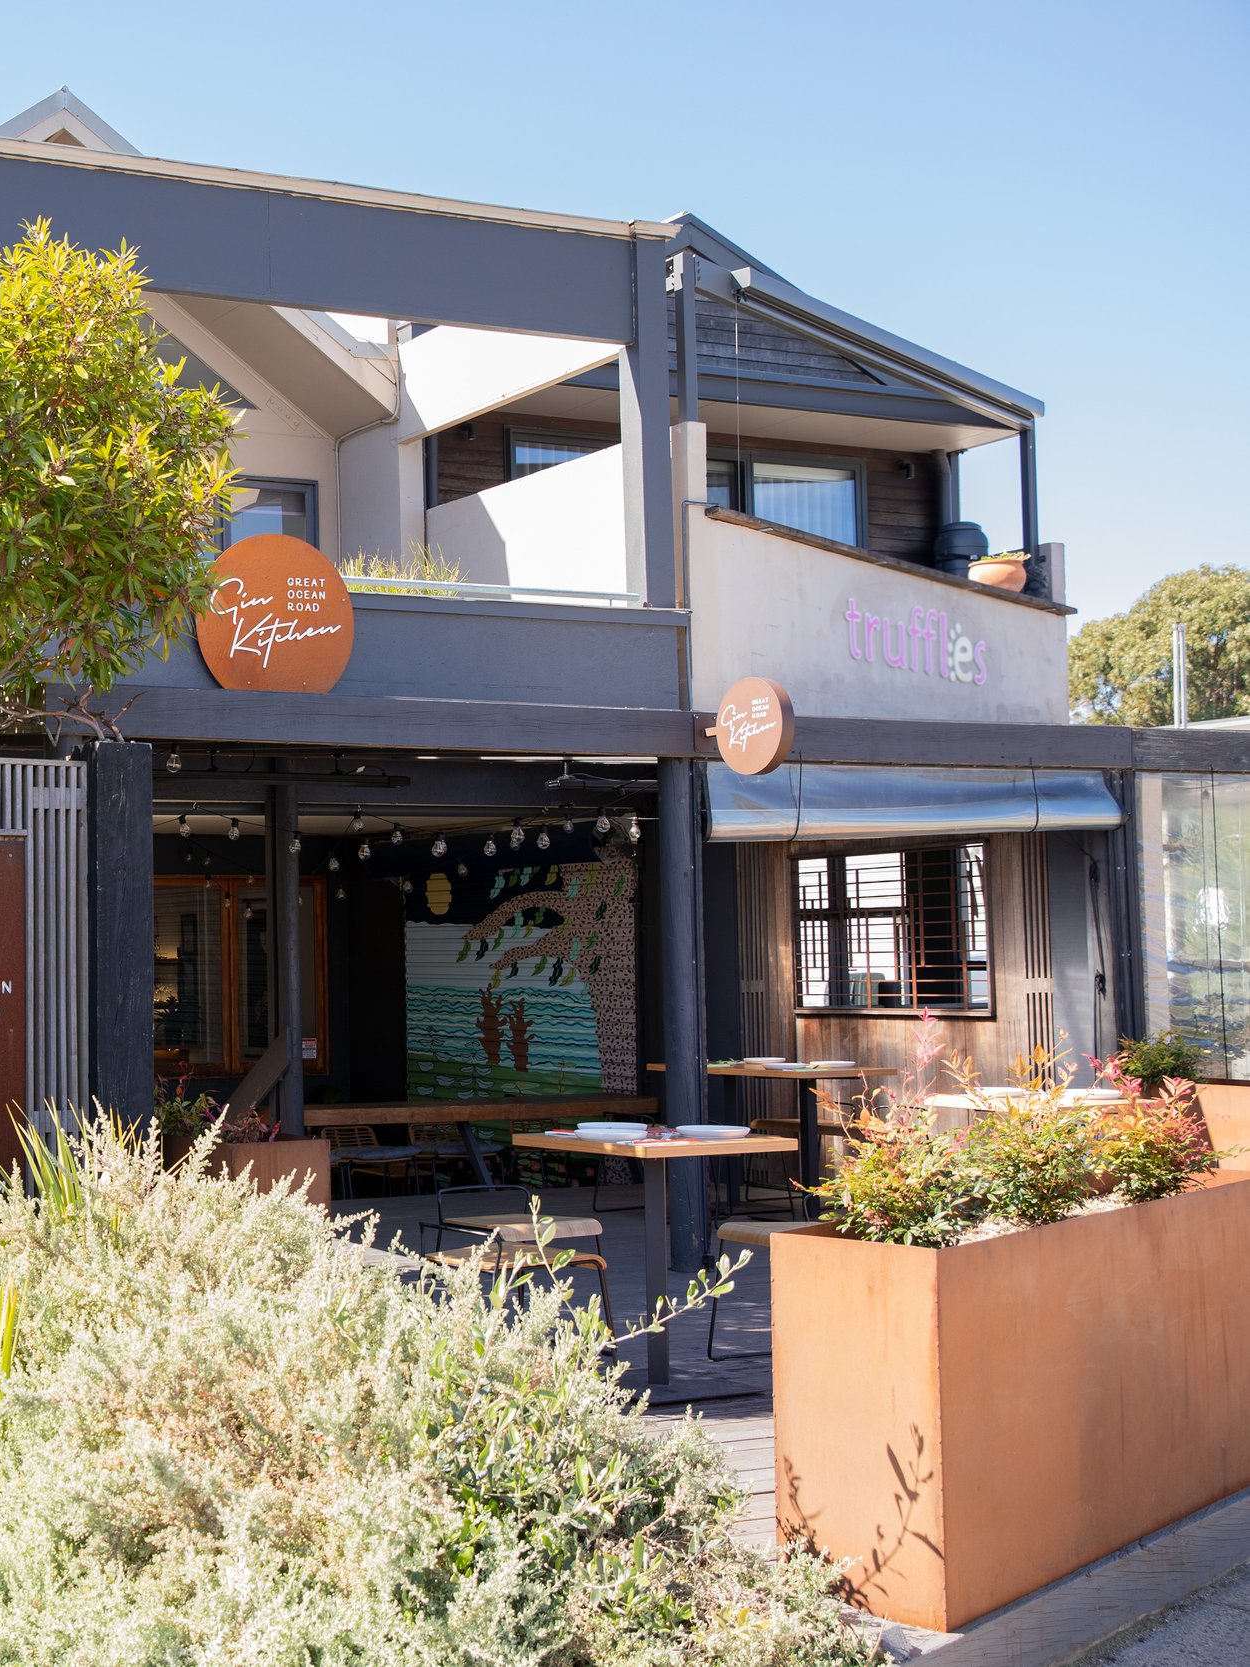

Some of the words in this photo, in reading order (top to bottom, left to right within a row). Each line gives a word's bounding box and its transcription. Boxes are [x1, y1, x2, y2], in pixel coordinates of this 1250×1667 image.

[287, 577, 326, 588] GREAT
[287, 590, 326, 600] OCEAN
[210, 577, 273, 624] Gin
[287, 602, 320, 612] ROAD
[229, 612, 342, 669] Kitchen
[845, 597, 987, 685] truffles
[721, 704, 747, 731] Gin
[729, 720, 776, 752] Kitchen
